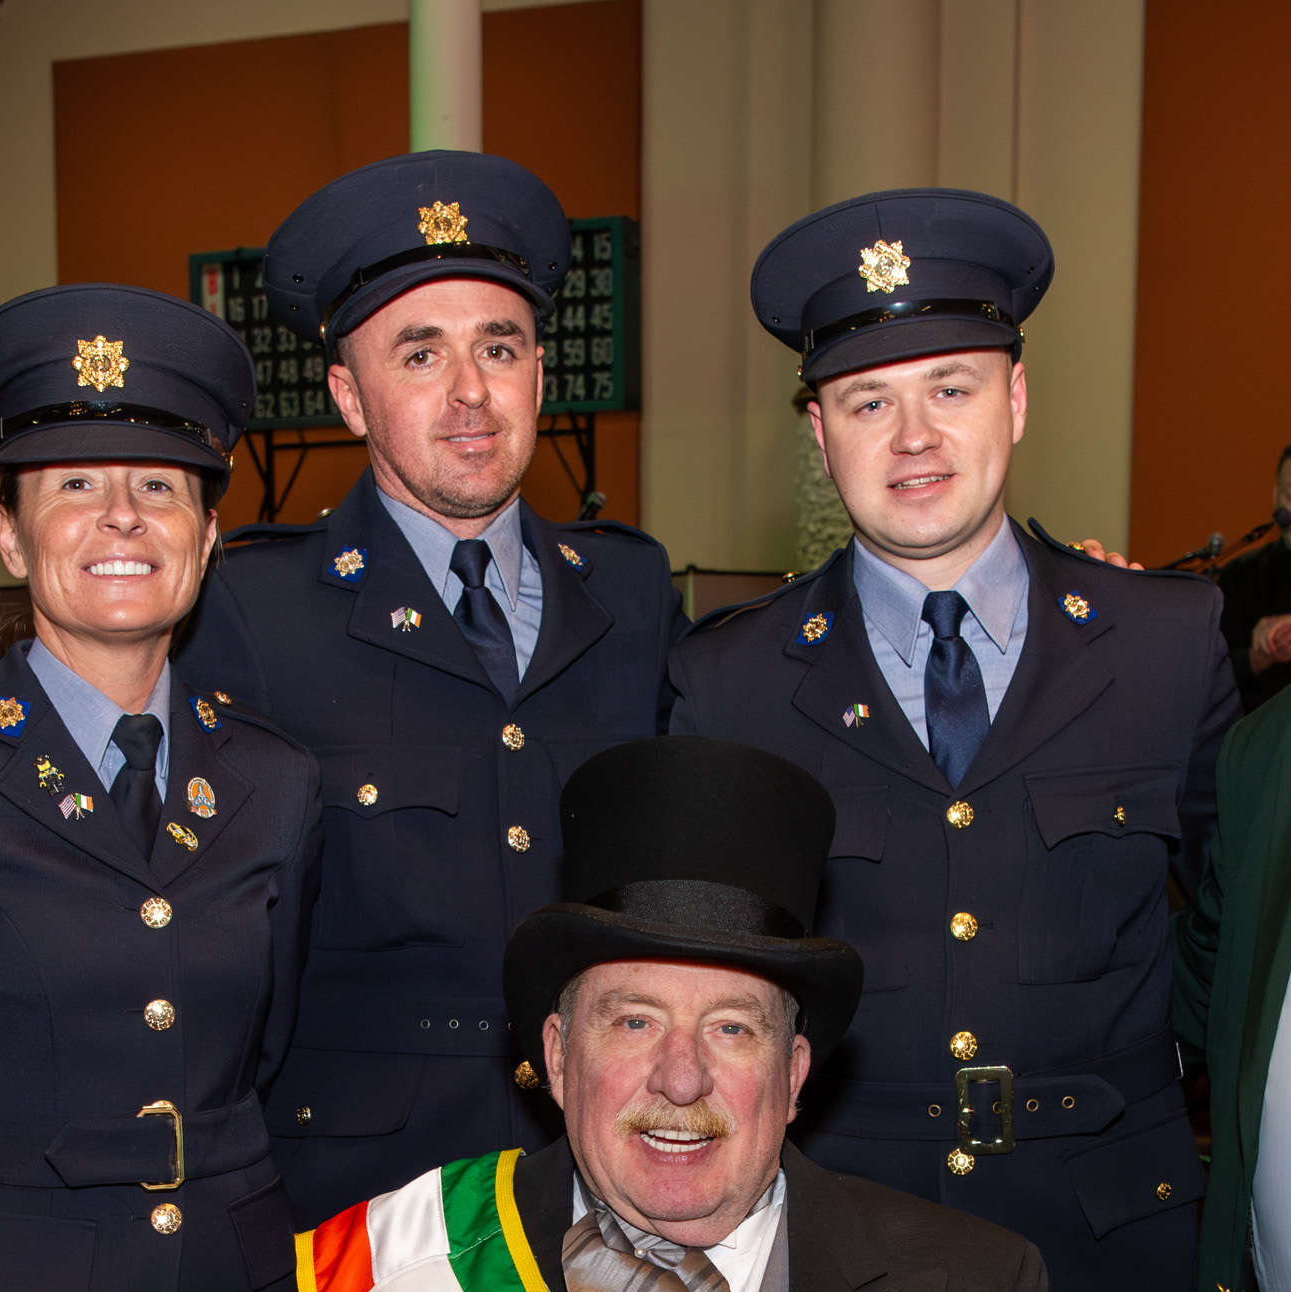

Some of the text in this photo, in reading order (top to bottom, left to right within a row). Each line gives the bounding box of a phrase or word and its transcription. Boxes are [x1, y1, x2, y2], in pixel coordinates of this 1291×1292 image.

[593, 231, 612, 261] 15
[251, 294, 268, 321] 17
[562, 267, 586, 299] 29
[589, 266, 613, 297] 30
[251, 325, 272, 354] 32
[563, 304, 586, 333] 44
[589, 302, 613, 331] 45
[278, 356, 299, 385] 48
[302, 354, 324, 383] 49
[562, 336, 585, 367] 59
[590, 336, 613, 366] 60
[254, 392, 275, 419] 62
[278, 390, 300, 417] 63
[303, 388, 325, 416] 64
[563, 373, 586, 401] 74
[590, 371, 613, 400] 75
